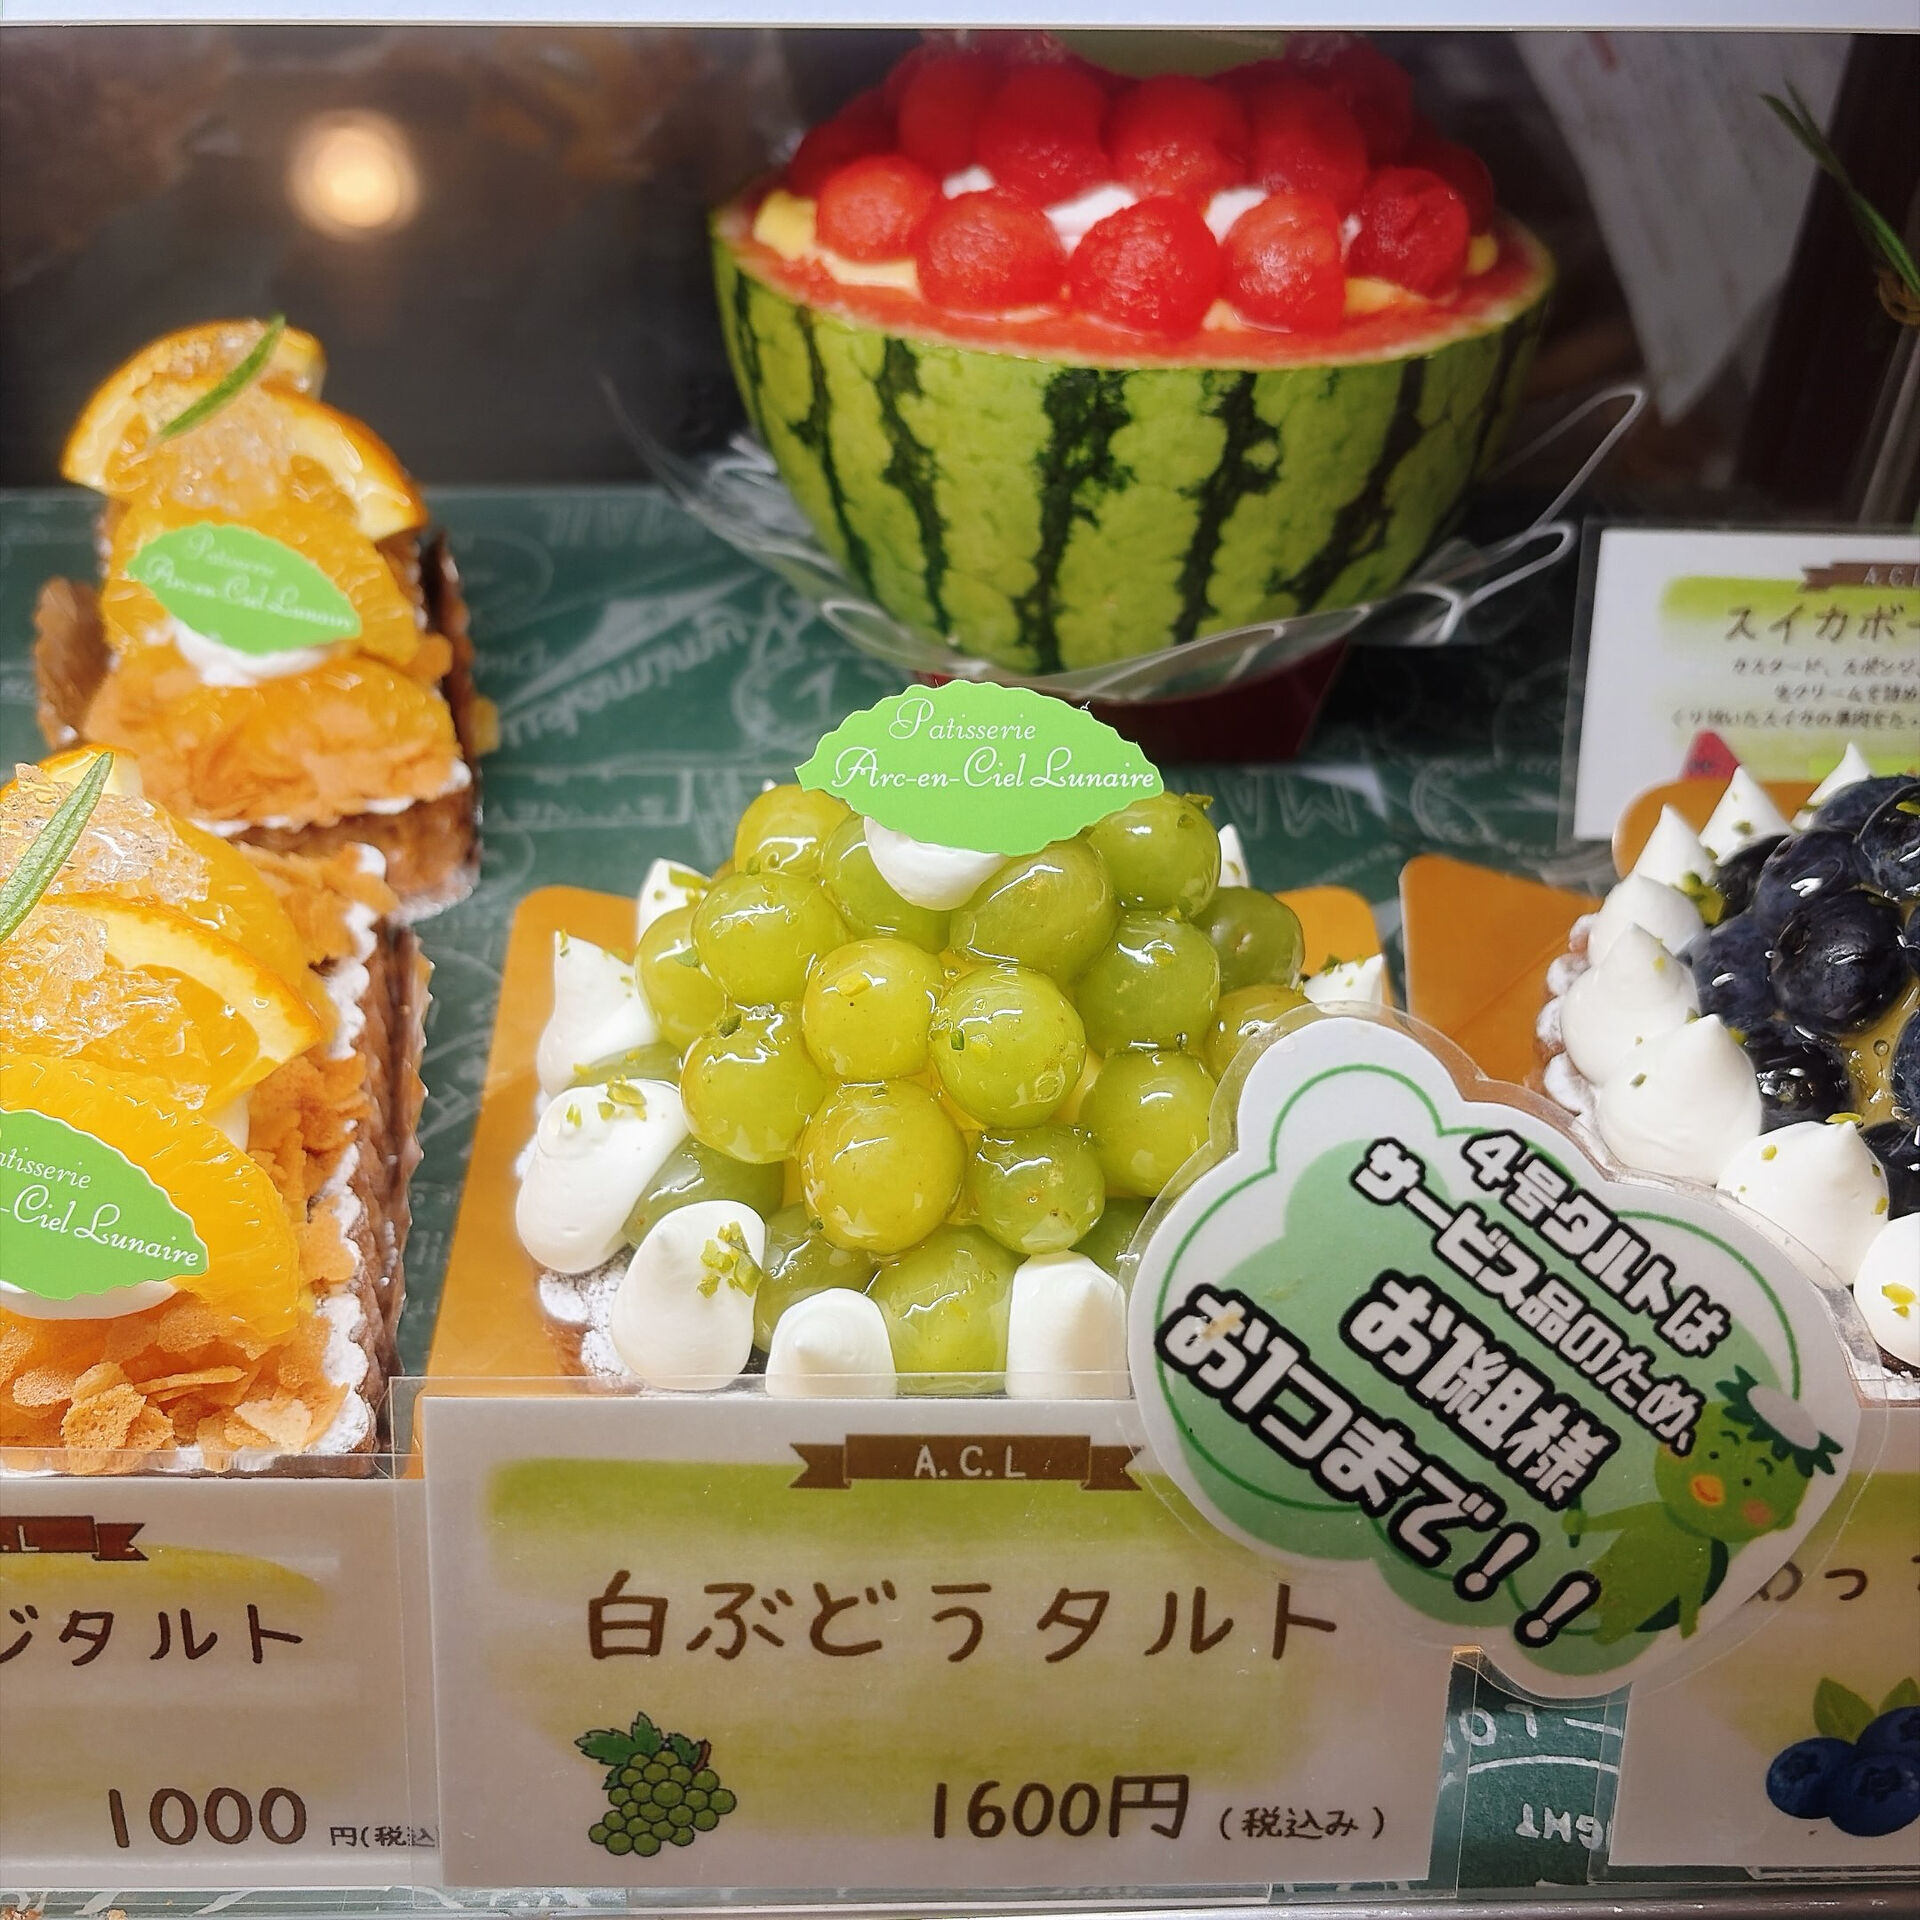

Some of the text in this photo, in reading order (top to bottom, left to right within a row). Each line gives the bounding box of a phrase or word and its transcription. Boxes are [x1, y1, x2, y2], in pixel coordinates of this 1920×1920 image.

[888, 697, 1037, 740] Patisserie
[831, 746, 1156, 789] Arc-en-Ciel Lunaire
[74, 1203, 200, 1267] Lunaire
[1461, 1130, 1731, 1357] 4号タルトは
[1351, 1138, 1706, 1456] サービス品のため、
[1341, 1270, 1620, 1510] お1組様
[914, 1444, 1027, 1478] A.C.L
[587, 1569, 1337, 1664] 白ぶどうタルト
[107, 1786, 440, 1849] 1000 円(税込
[933, 1774, 1386, 1841] 1600円 (税込み)
